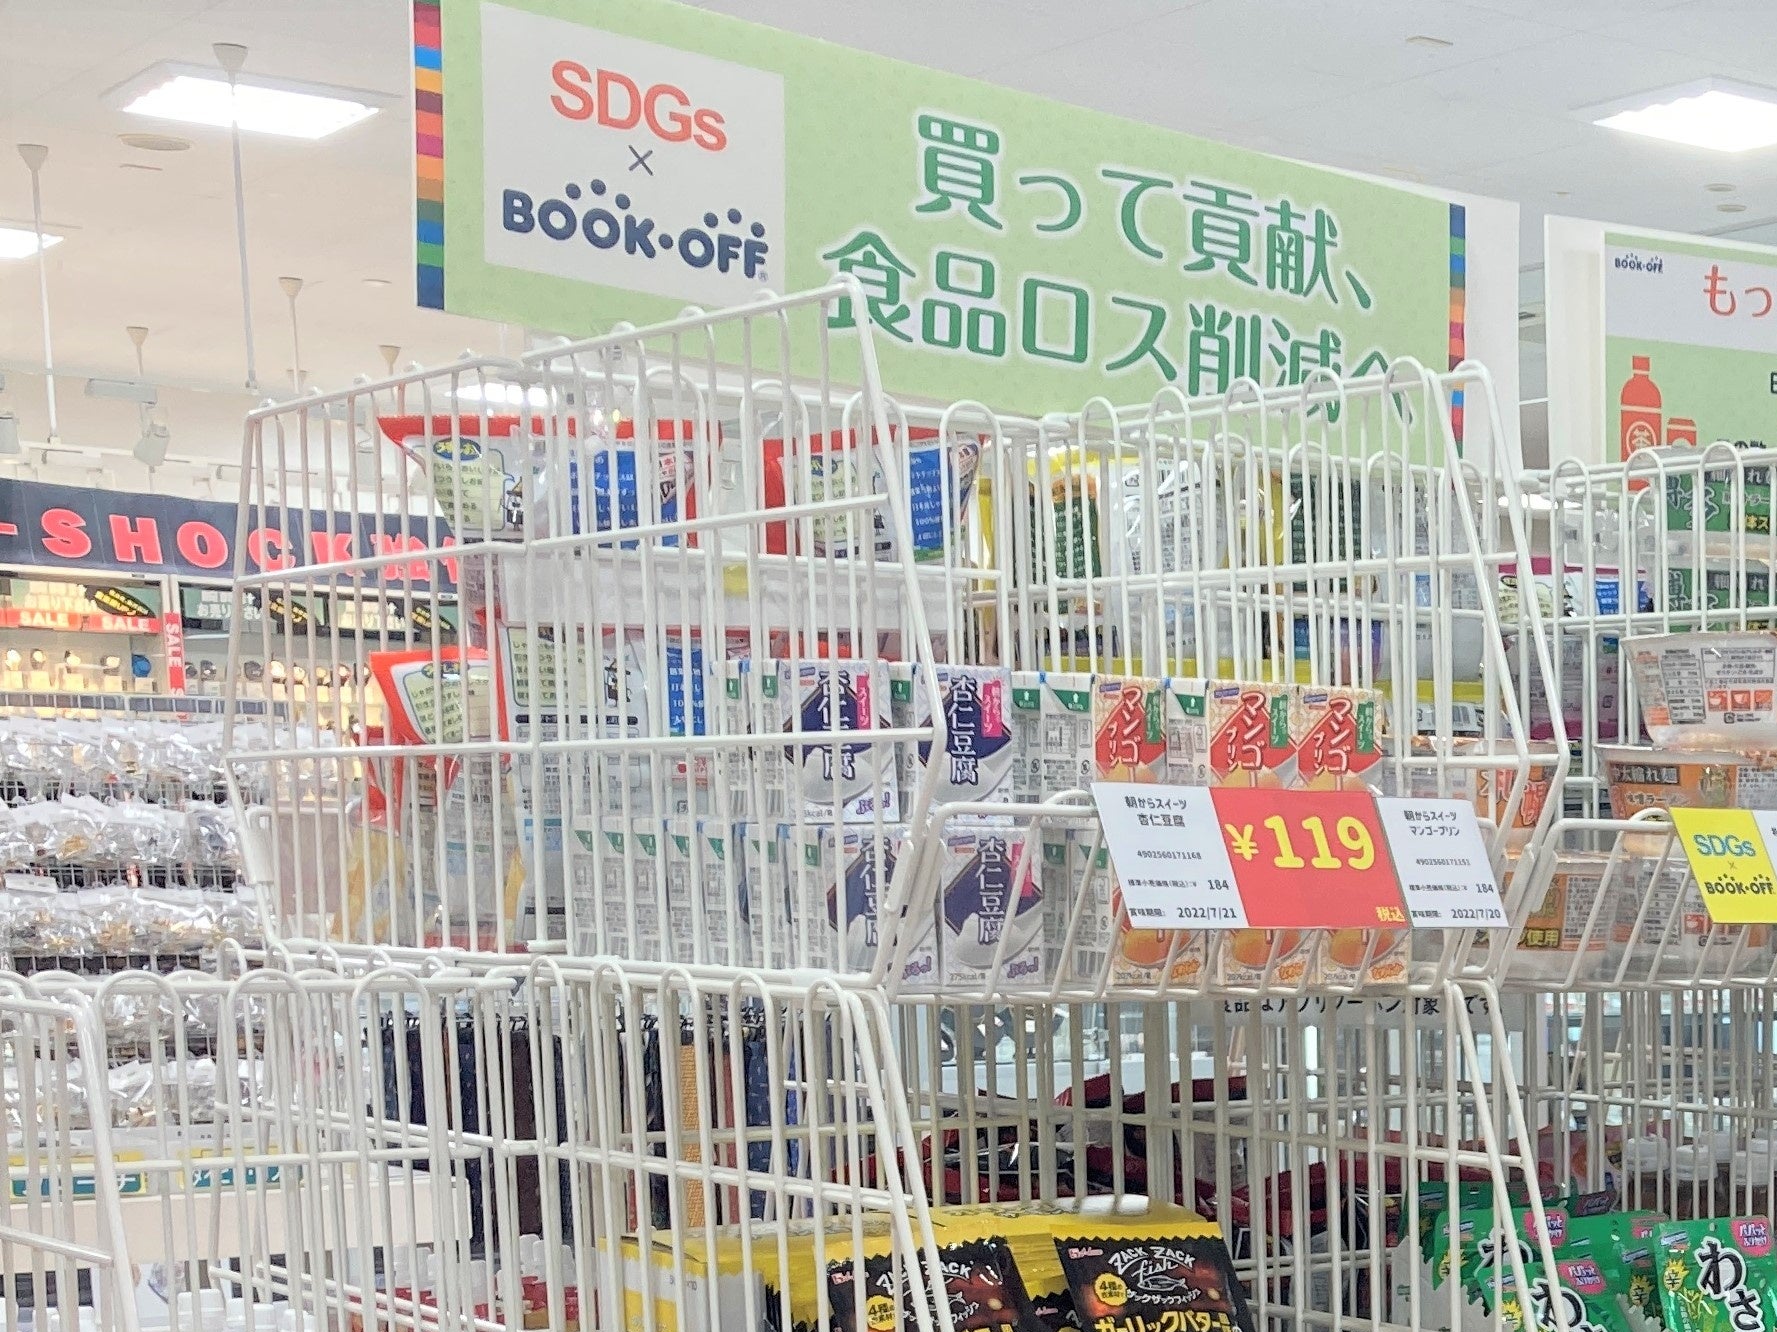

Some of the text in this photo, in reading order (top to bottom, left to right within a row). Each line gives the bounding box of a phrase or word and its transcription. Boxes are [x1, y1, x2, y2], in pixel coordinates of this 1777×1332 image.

[551, 60, 727, 152] SDGs
[916, 114, 1372, 309] 買って貢献、
[946, 674, 980, 785] 杏仁豆腐
[1224, 814, 1377, 871] ¥119
[1692, 833, 1757, 859] SDGs
[1207, 877, 1231, 893] 184
[1474, 882, 1496, 895] 184
[1176, 905, 1239, 922] 2022/7/21
[1450, 908, 1502, 919] 2022/7/20
[1108, 1246, 1197, 1276] ZACK ZACK
